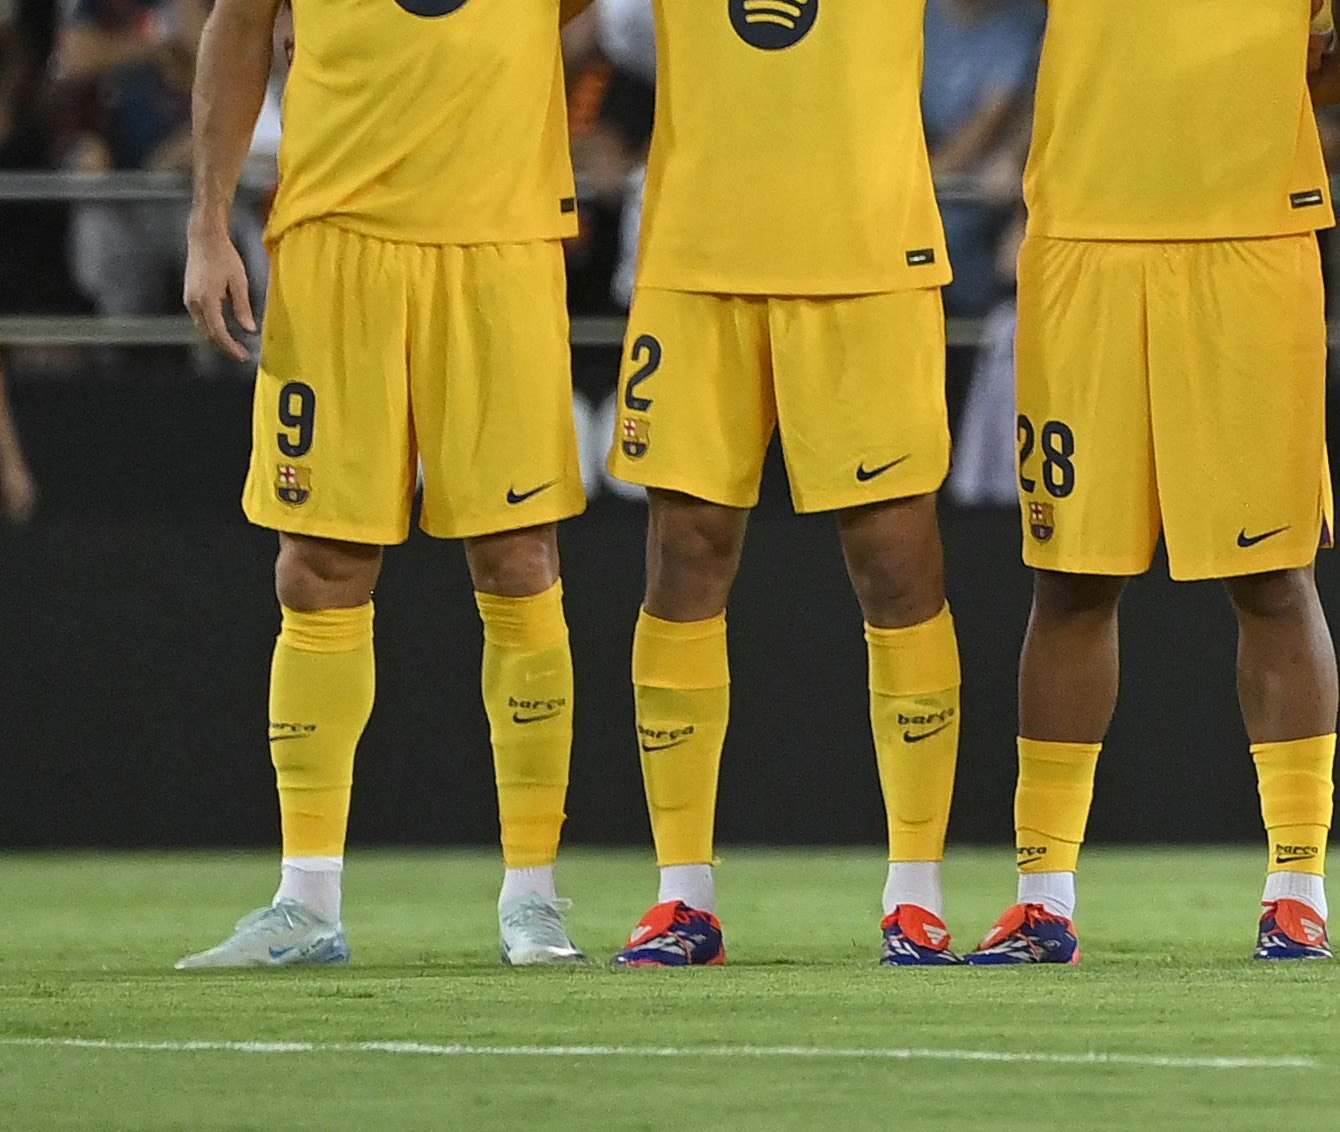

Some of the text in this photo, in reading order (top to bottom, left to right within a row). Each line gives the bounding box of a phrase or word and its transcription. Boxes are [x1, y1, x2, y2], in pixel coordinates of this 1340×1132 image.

[625, 334, 663, 412] 2
[277, 381, 317, 458] 9
[1019, 414, 1075, 499] 28
